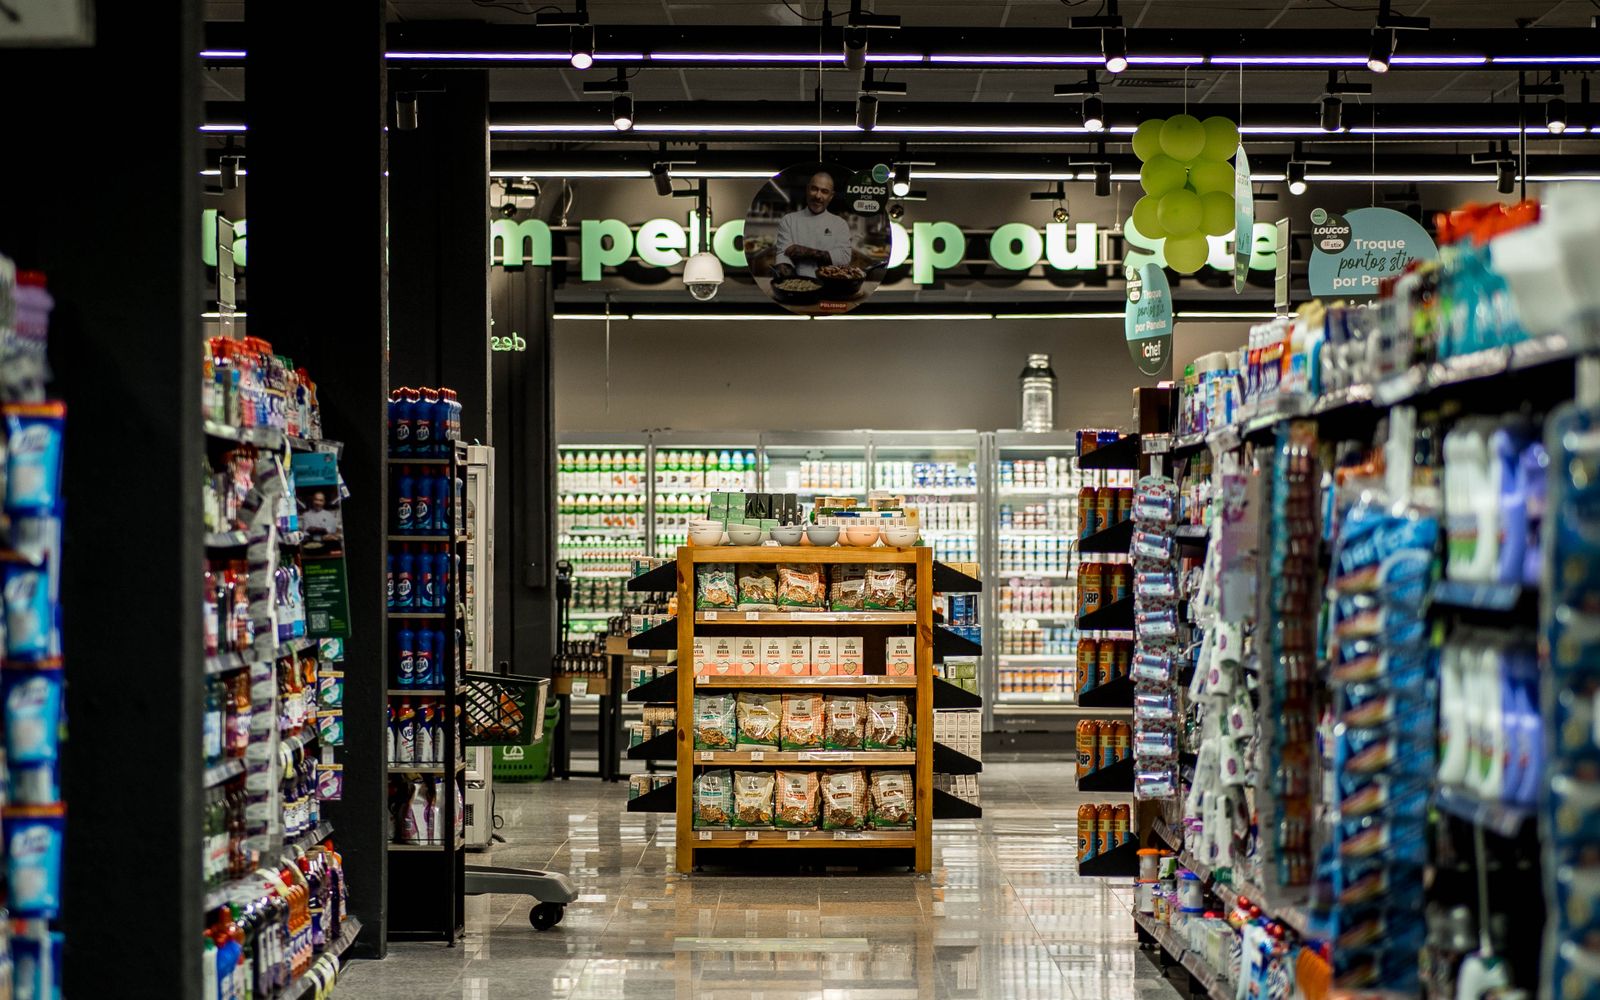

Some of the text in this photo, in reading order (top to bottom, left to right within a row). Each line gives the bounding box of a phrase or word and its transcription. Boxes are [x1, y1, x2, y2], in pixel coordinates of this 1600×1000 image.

[847, 185, 887, 195] LOUCOS
[1313, 226, 1349, 235] LOUCOS
[990, 222, 1098, 271] ou
[1354, 239, 1406, 252] Troque
[1337, 250, 1386, 277] pontos
[1333, 277, 1357, 290] por
